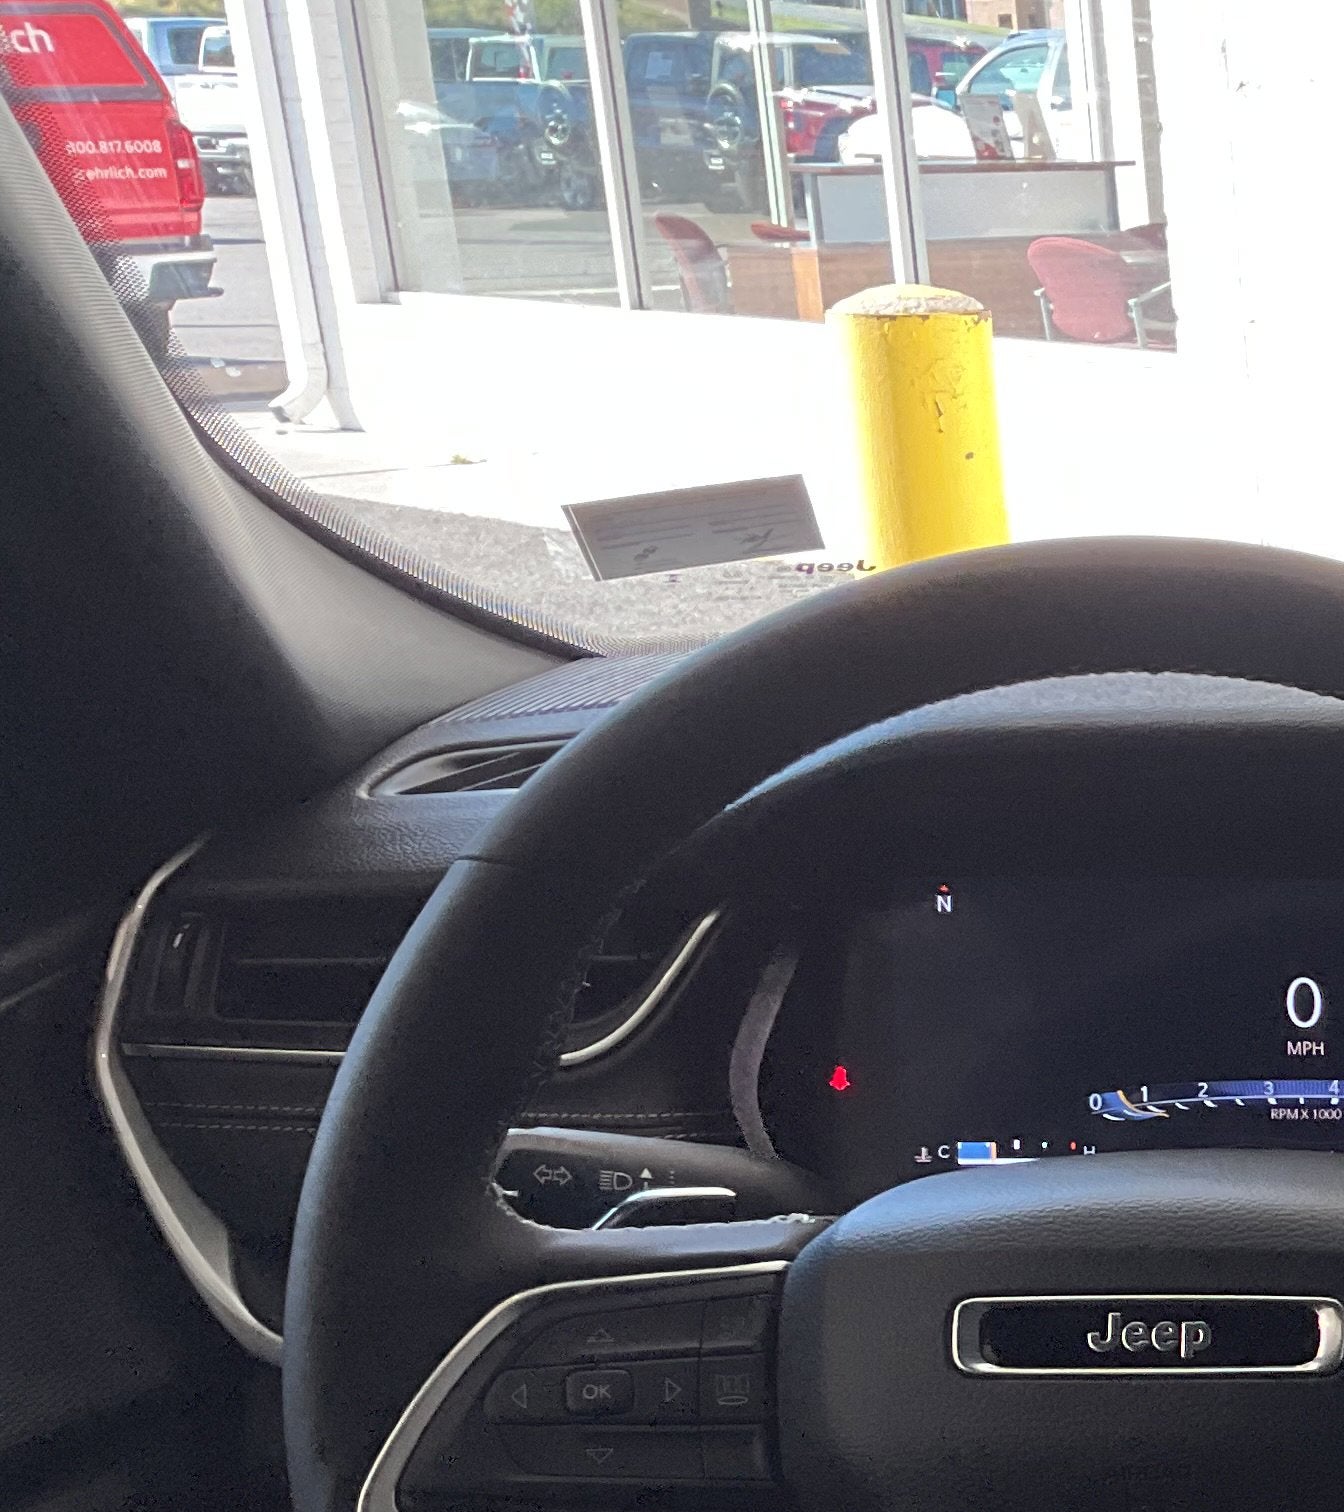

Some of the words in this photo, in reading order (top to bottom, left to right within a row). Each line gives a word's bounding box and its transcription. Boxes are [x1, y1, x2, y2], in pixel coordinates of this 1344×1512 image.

[935, 894, 953, 912] N
[1286, 976, 1322, 1028] 0
[1287, 1041, 1325, 1056] MPH
[1140, 1085, 1148, 1102] 1
[1198, 1082, 1209, 1098] 2
[1263, 1081, 1274, 1095] 3
[1328, 1079, 1340, 1095] 4
[1089, 1093, 1103, 1111] 0
[1270, 1108, 1299, 1120] RPM
[1312, 1108, 1342, 1121] 1000
[937, 1144, 950, 1159] C
[1086, 1311, 1212, 1359] Jeep
[582, 1384, 612, 1400] OK
